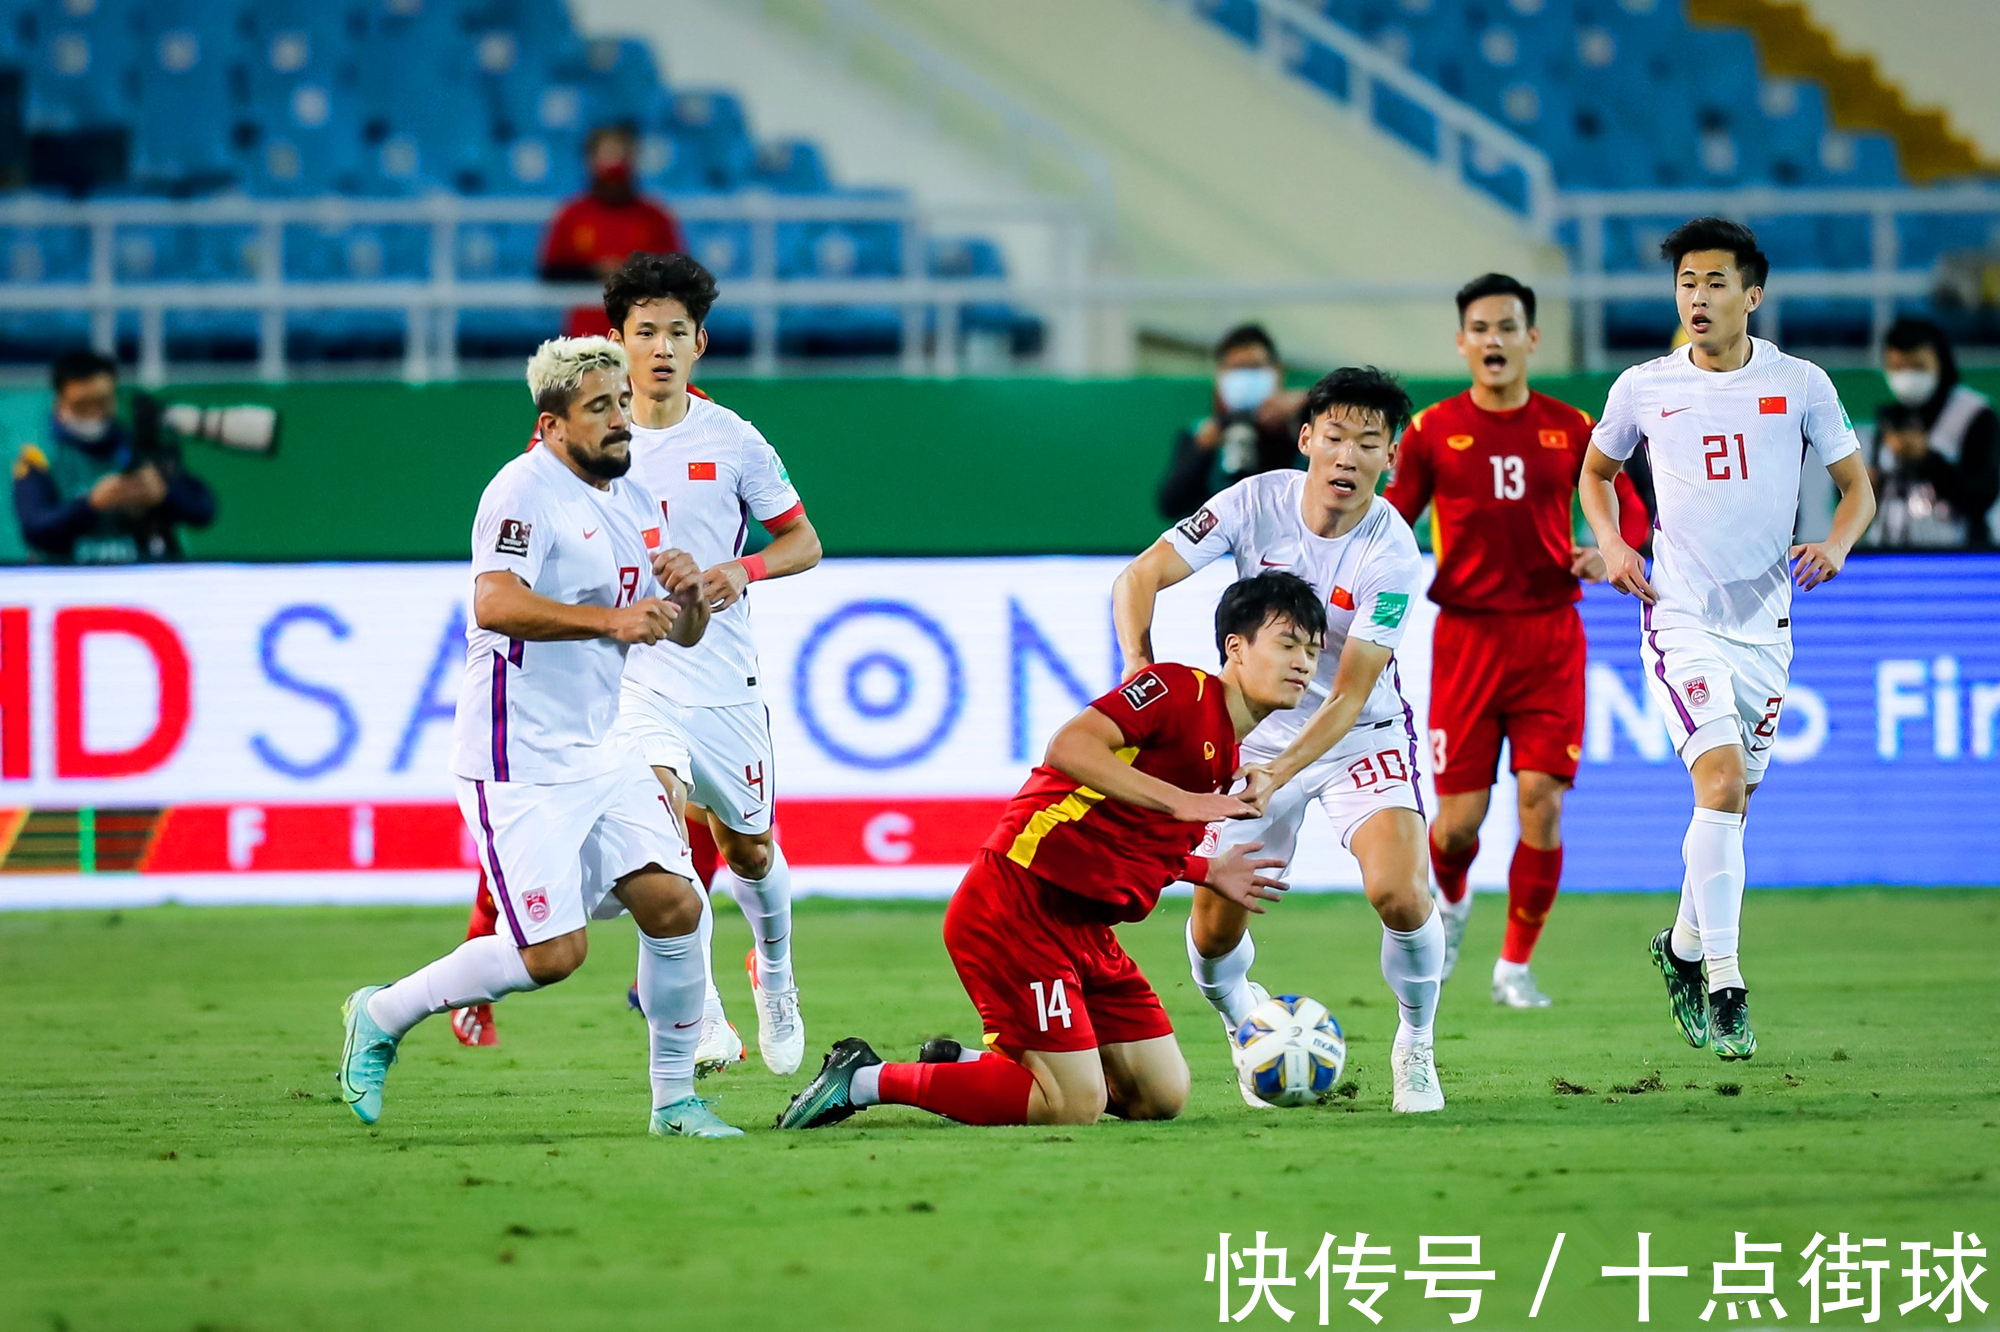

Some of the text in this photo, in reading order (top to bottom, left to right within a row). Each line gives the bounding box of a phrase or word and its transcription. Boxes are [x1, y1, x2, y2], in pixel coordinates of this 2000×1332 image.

[1488, 455, 1526, 500] 13
[1702, 433, 1748, 480] 21
[0, 606, 192, 781] D
[1754, 694, 1785, 737] 2
[745, 760, 764, 802] 4
[1347, 749, 1408, 789] 20
[1029, 978, 1072, 1032] 14
